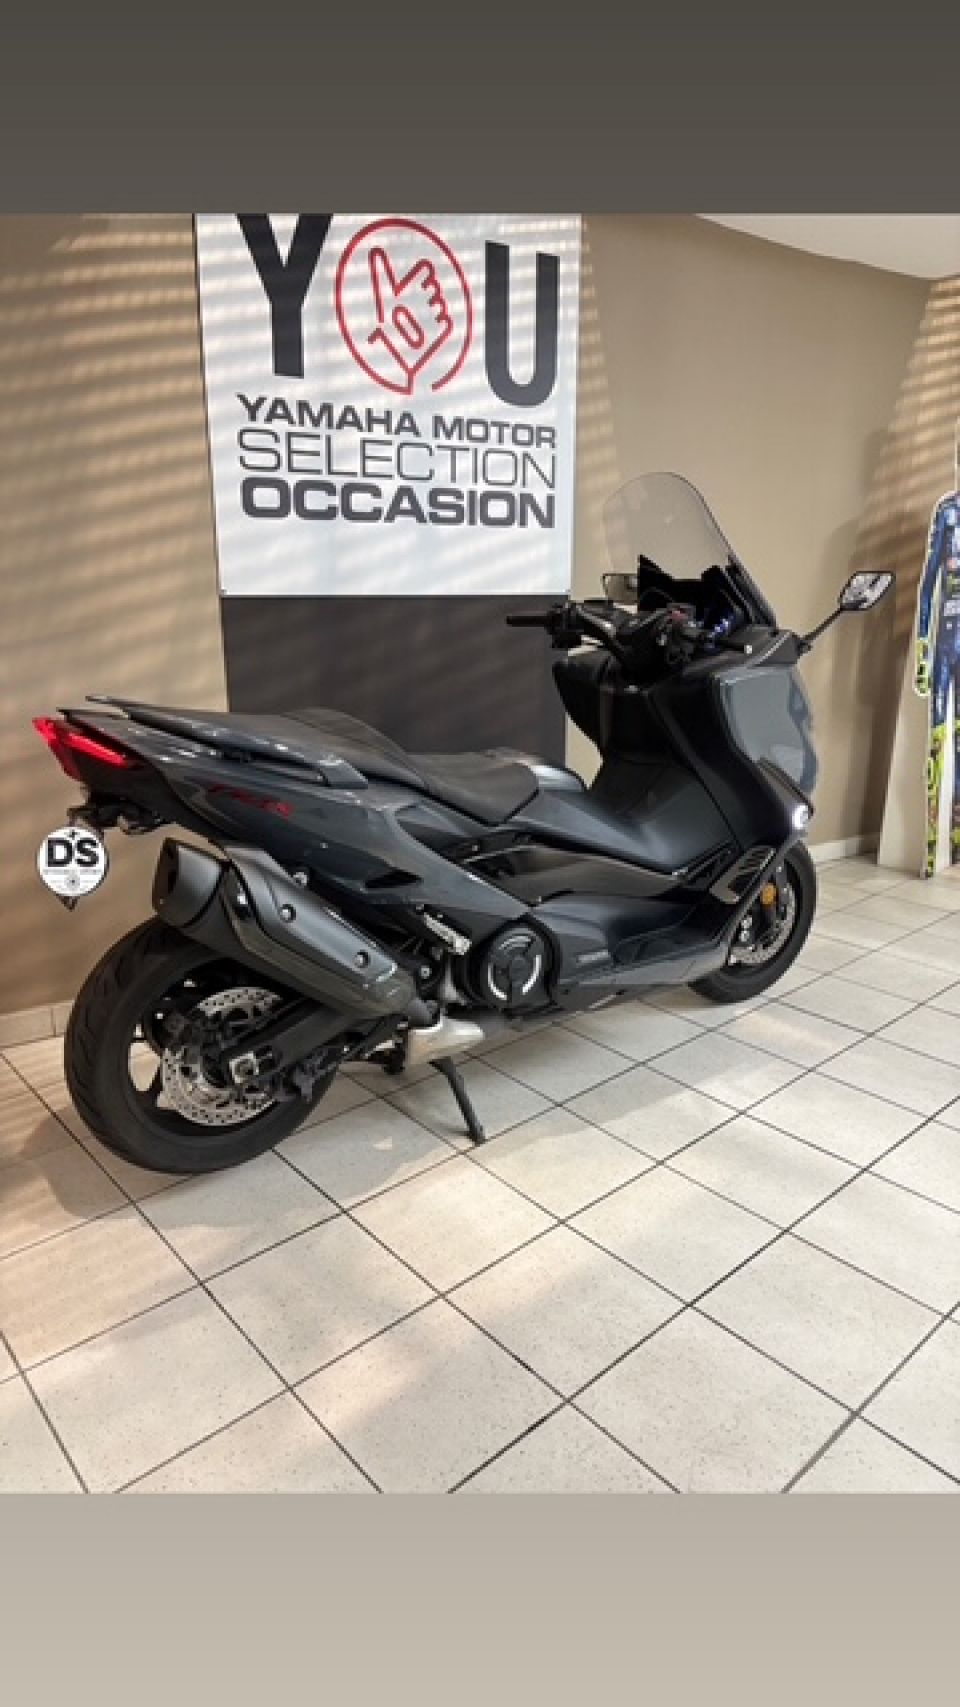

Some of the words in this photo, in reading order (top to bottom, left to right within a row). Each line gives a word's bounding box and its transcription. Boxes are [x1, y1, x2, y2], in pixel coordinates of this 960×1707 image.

[237, 394, 421, 438] YAMAHA
[432, 415, 556, 449] MOTOR
[237, 428, 556, 489] SELECTION
[241, 476, 556, 529] OCCASION
